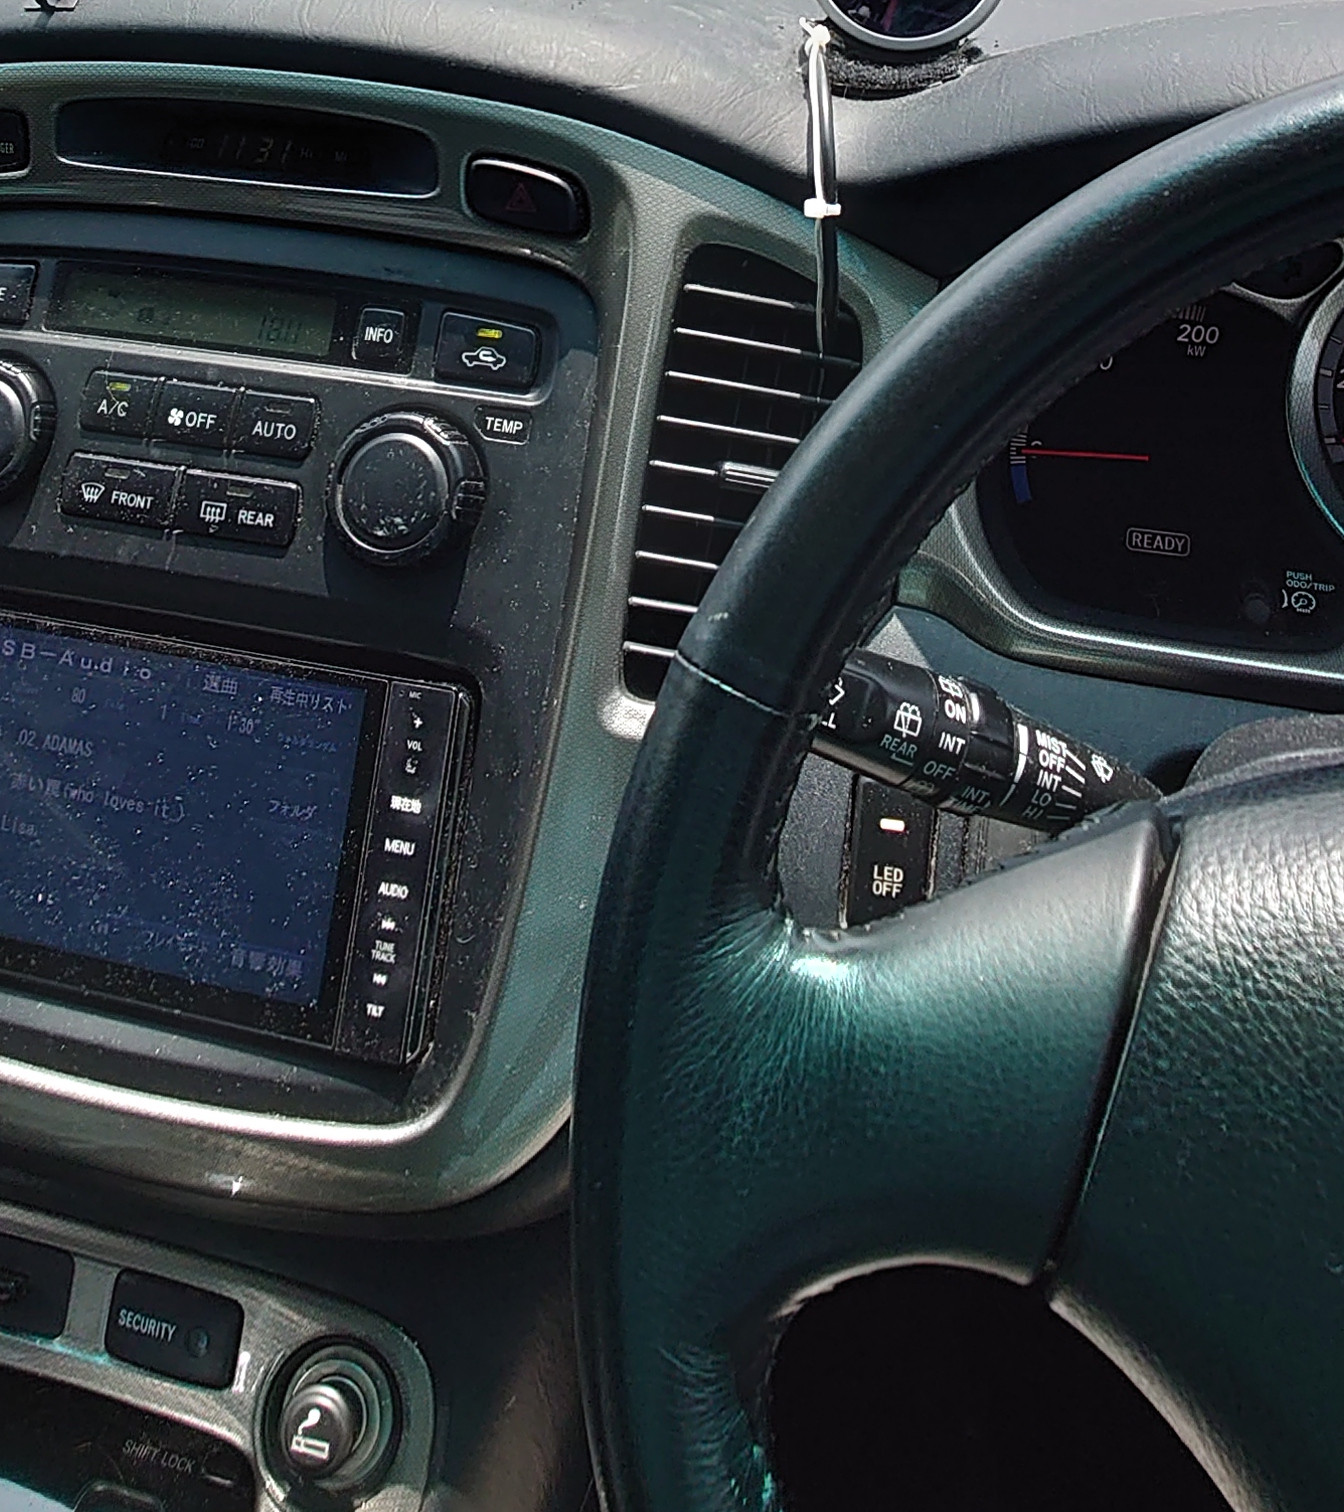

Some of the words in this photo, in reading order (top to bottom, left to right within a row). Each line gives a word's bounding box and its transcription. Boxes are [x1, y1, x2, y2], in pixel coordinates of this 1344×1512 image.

[364, 326, 394, 344] INFO
[1176, 323, 1220, 344] 200
[1187, 345, 1206, 358] kW
[96, 398, 129, 417] A/C
[184, 411, 217, 430] OFF
[484, 416, 523, 434] TEMP
[252, 420, 297, 441] AUTO
[110, 491, 154, 510] FRONT
[237, 509, 274, 528] REAR
[1131, 532, 1186, 552] READY
[1286, 570, 1313, 581] PUSH
[1285, 579, 1335, 593] ODO/TRIP
[202, 674, 239, 696] 選曲
[269, 685, 348, 715] 再生中リスト
[408, 690, 422, 699] MIC
[944, 699, 966, 724] ON
[406, 740, 423, 752] VOL
[880, 734, 918, 758] REAR
[938, 731, 966, 755] INT
[1035, 729, 1067, 757] MIST
[923, 760, 956, 780] OFF
[1038, 749, 1066, 773] OFF
[1036, 769, 1062, 792] INT
[961, 785, 990, 802] INT
[1031, 789, 1052, 807] LO
[390, 796, 422, 814] 現在地
[949, 796, 981, 813] TIME
[1022, 807, 1044, 819] HI
[384, 838, 416, 856] MENU
[873, 864, 904, 881] LED
[377, 882, 409, 899] AUDIO
[872, 881, 903, 898] OFF
[375, 939, 395, 952] TUNE
[371, 950, 396, 964] TRACK
[365, 1004, 385, 1018] TILT
[117, 1306, 177, 1345] SECURITY
[122, 1438, 160, 1462] SHIFT
[161, 1451, 196, 1475] LOCK
